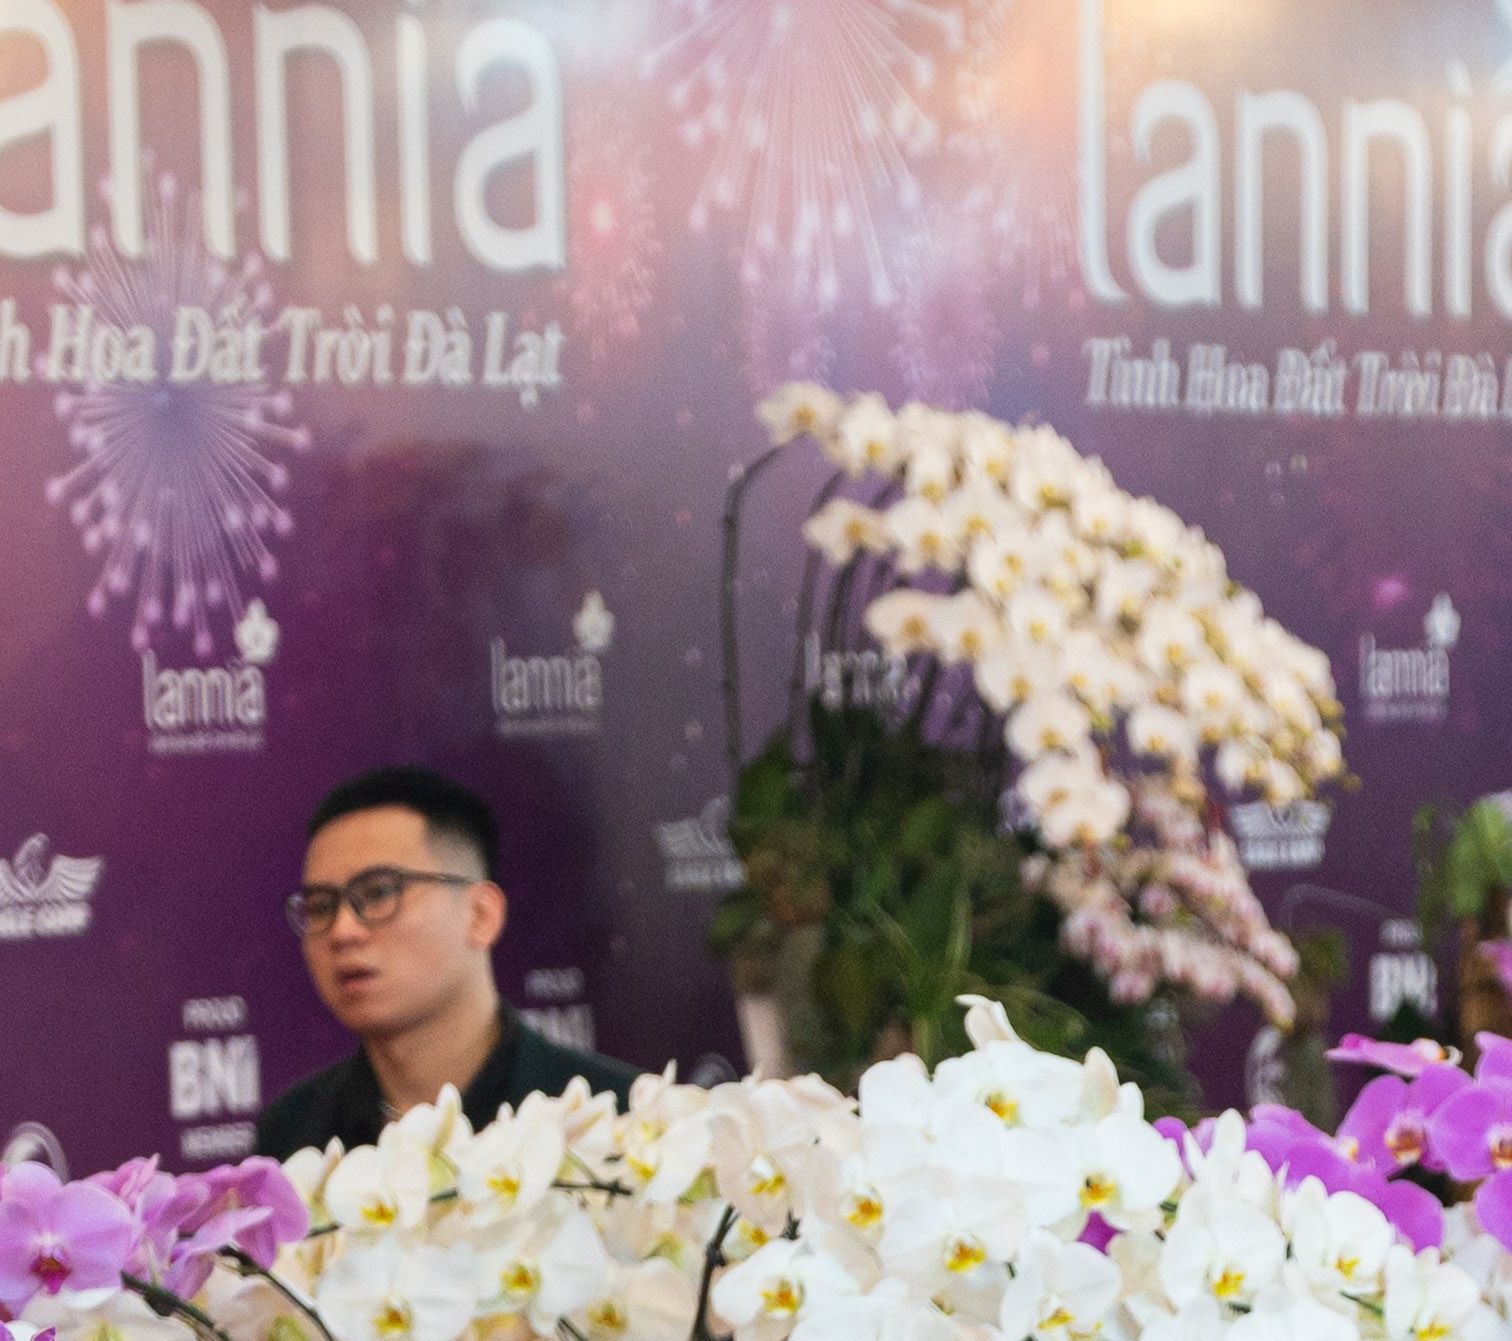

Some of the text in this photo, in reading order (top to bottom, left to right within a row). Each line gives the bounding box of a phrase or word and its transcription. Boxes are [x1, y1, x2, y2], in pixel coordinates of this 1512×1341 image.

[44, 302, 157, 386] Hoa
[141, 648, 267, 730] lannia
[490, 636, 603, 714] lannia
[1359, 630, 1451, 698] lannia
[168, 1034, 261, 1120] BNI
